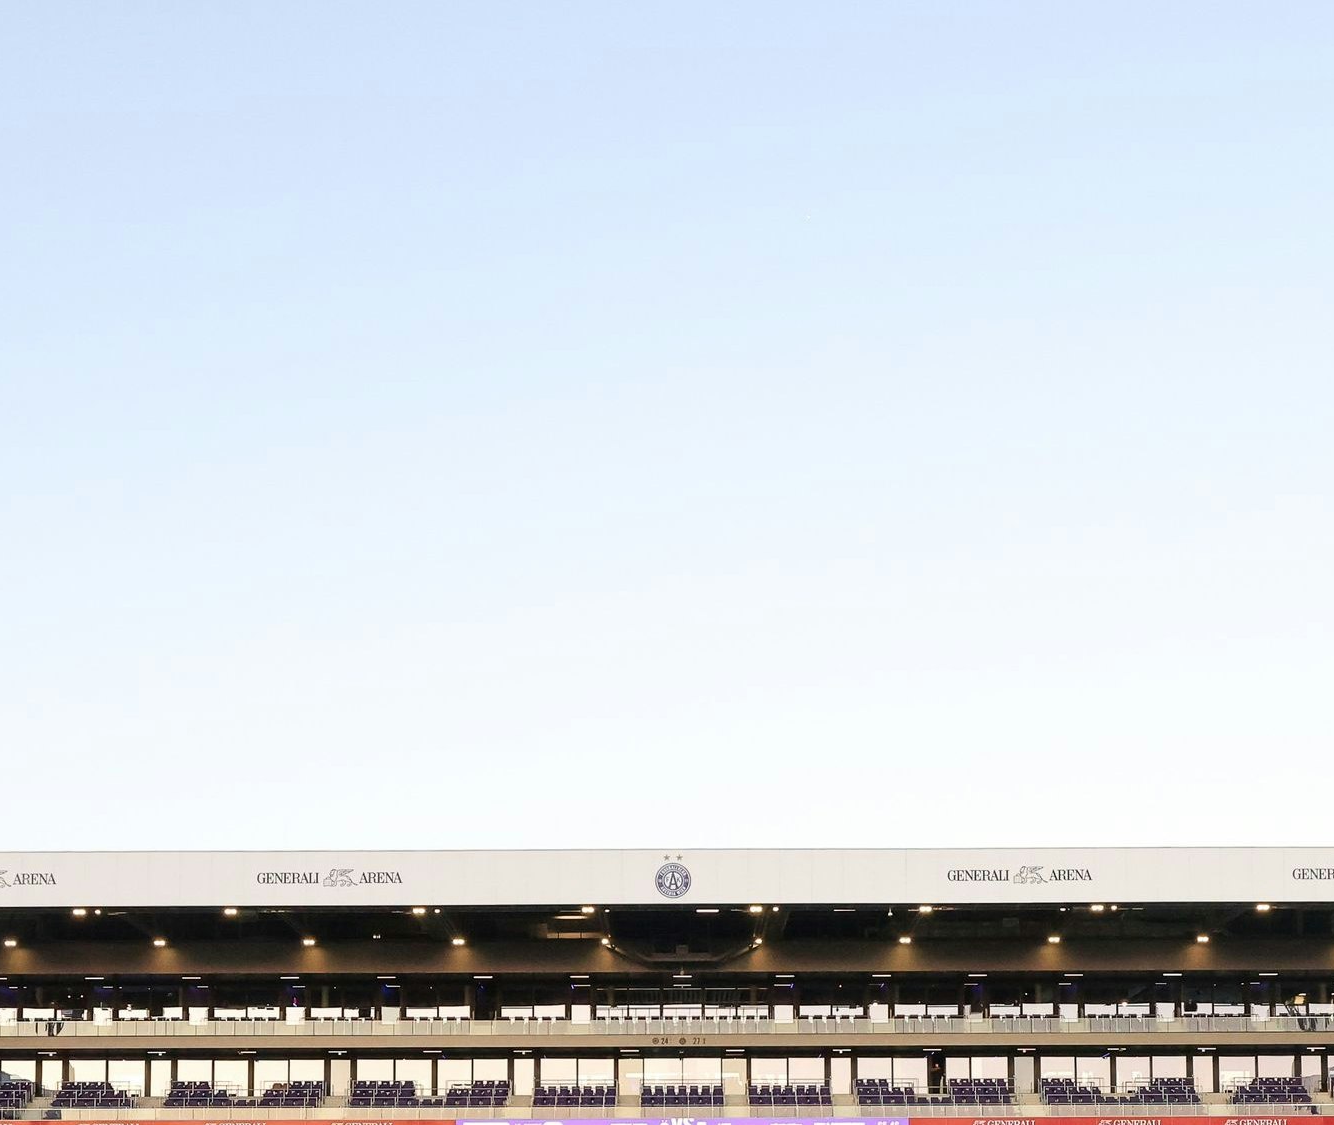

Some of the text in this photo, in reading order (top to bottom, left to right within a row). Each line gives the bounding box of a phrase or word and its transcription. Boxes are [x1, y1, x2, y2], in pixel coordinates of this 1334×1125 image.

[12, 872, 57, 886] ARENA
[256, 871, 403, 885] GENERALI ARENA
[947, 868, 1093, 882] GENERALI ARENA
